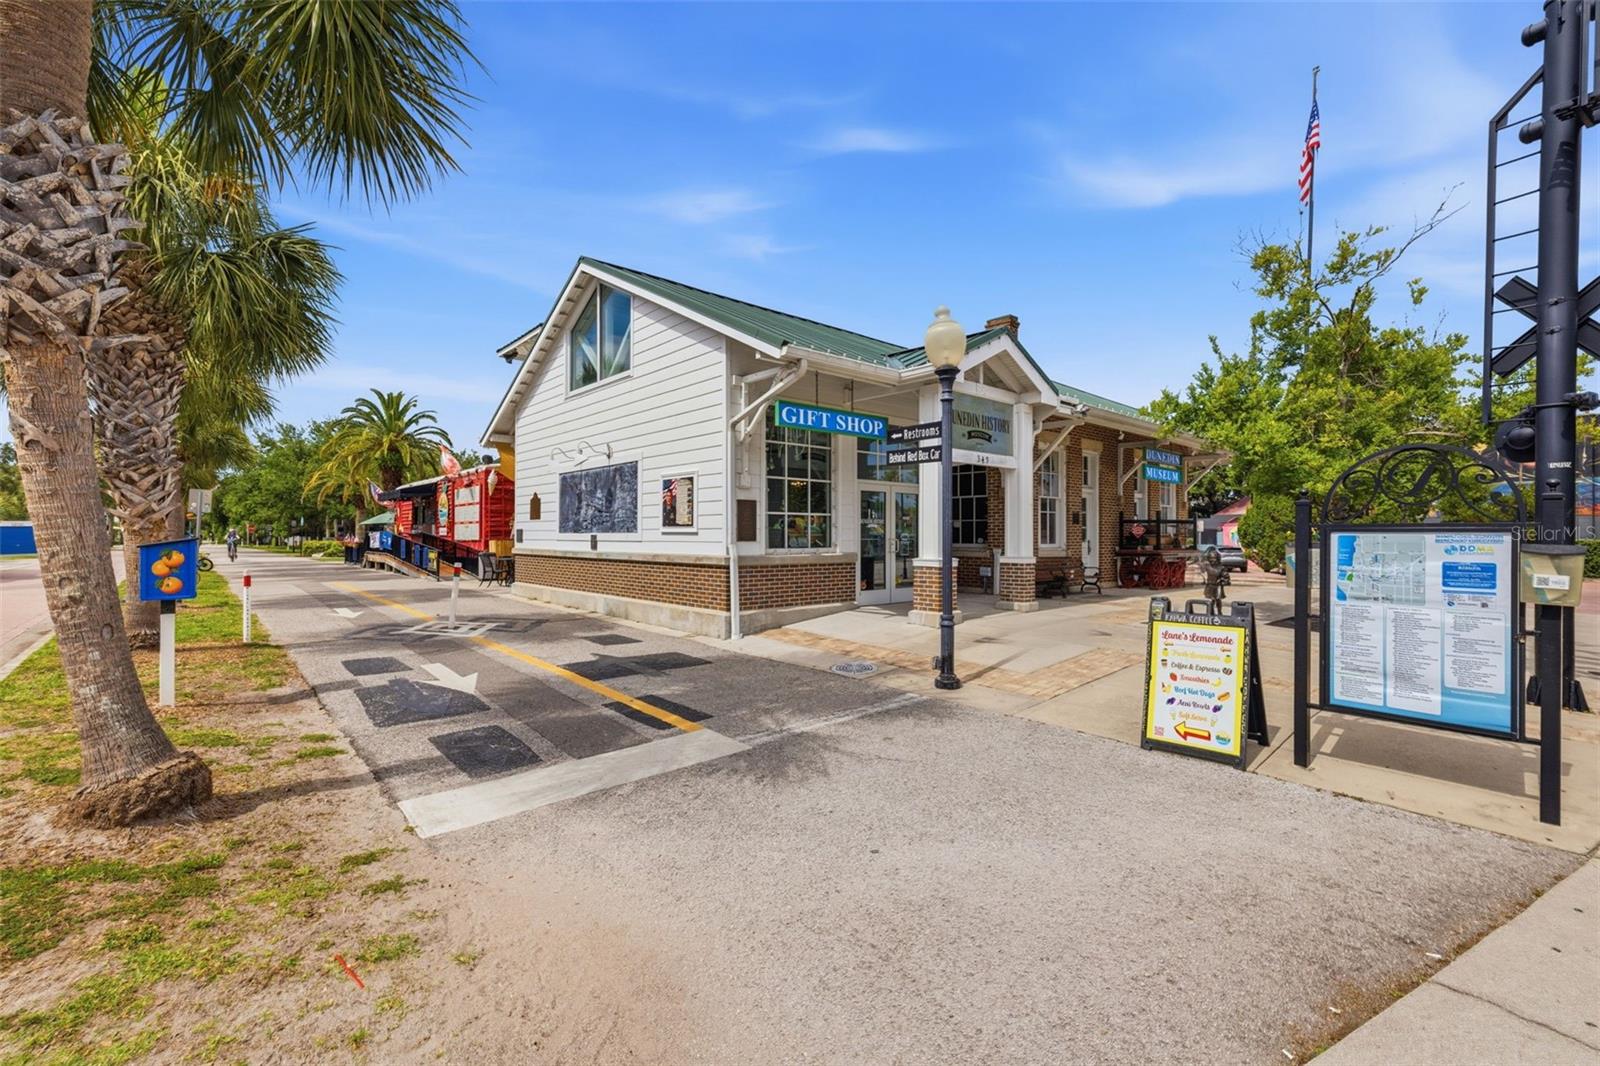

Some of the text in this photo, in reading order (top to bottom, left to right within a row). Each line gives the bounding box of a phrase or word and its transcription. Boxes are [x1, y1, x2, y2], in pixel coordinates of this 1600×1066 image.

[781, 406, 883, 435] GIFT SHOP
[952, 409, 1010, 434] UNEDIN HISTORY
[903, 426, 940, 440] Restrooms
[889, 448, 941, 463] Behind Red Box Car
[1146, 449, 1180, 465] DUNEDIN
[1146, 467, 1179, 482] MUSEUM
[1161, 630, 1234, 645] Lane's Lemonade
[1171, 661, 1187, 671] Coffee
[1180, 674, 1210, 684] Smoothies
[1200, 689, 1215, 699] Dogs
